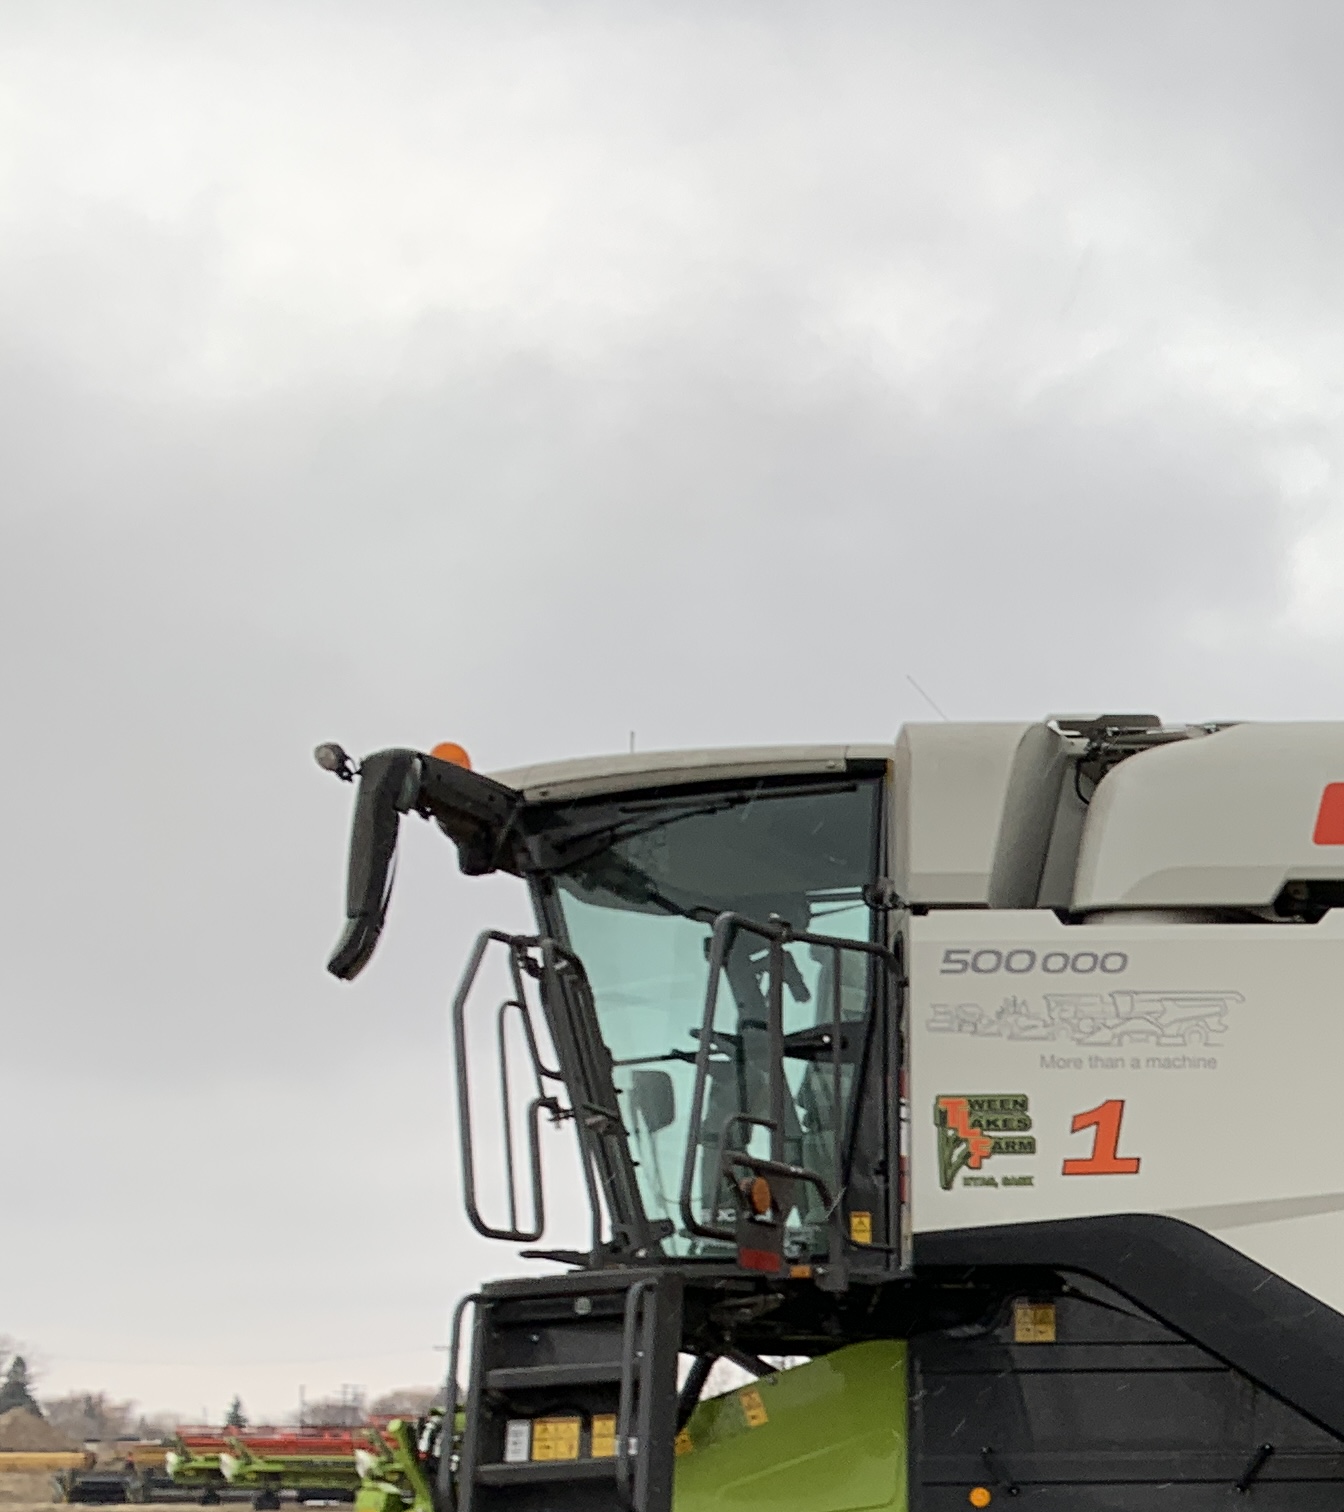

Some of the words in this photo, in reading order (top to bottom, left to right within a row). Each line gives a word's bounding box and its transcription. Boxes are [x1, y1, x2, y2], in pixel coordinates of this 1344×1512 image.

[940, 949, 1036, 975] 500
[1041, 951, 1129, 975] 000
[1039, 1054, 1083, 1070] More
[1088, 1055, 1126, 1070] than
[1130, 1057, 1142, 1070] a
[1146, 1055, 1218, 1070] machine
[1062, 1099, 1141, 1176] 1
